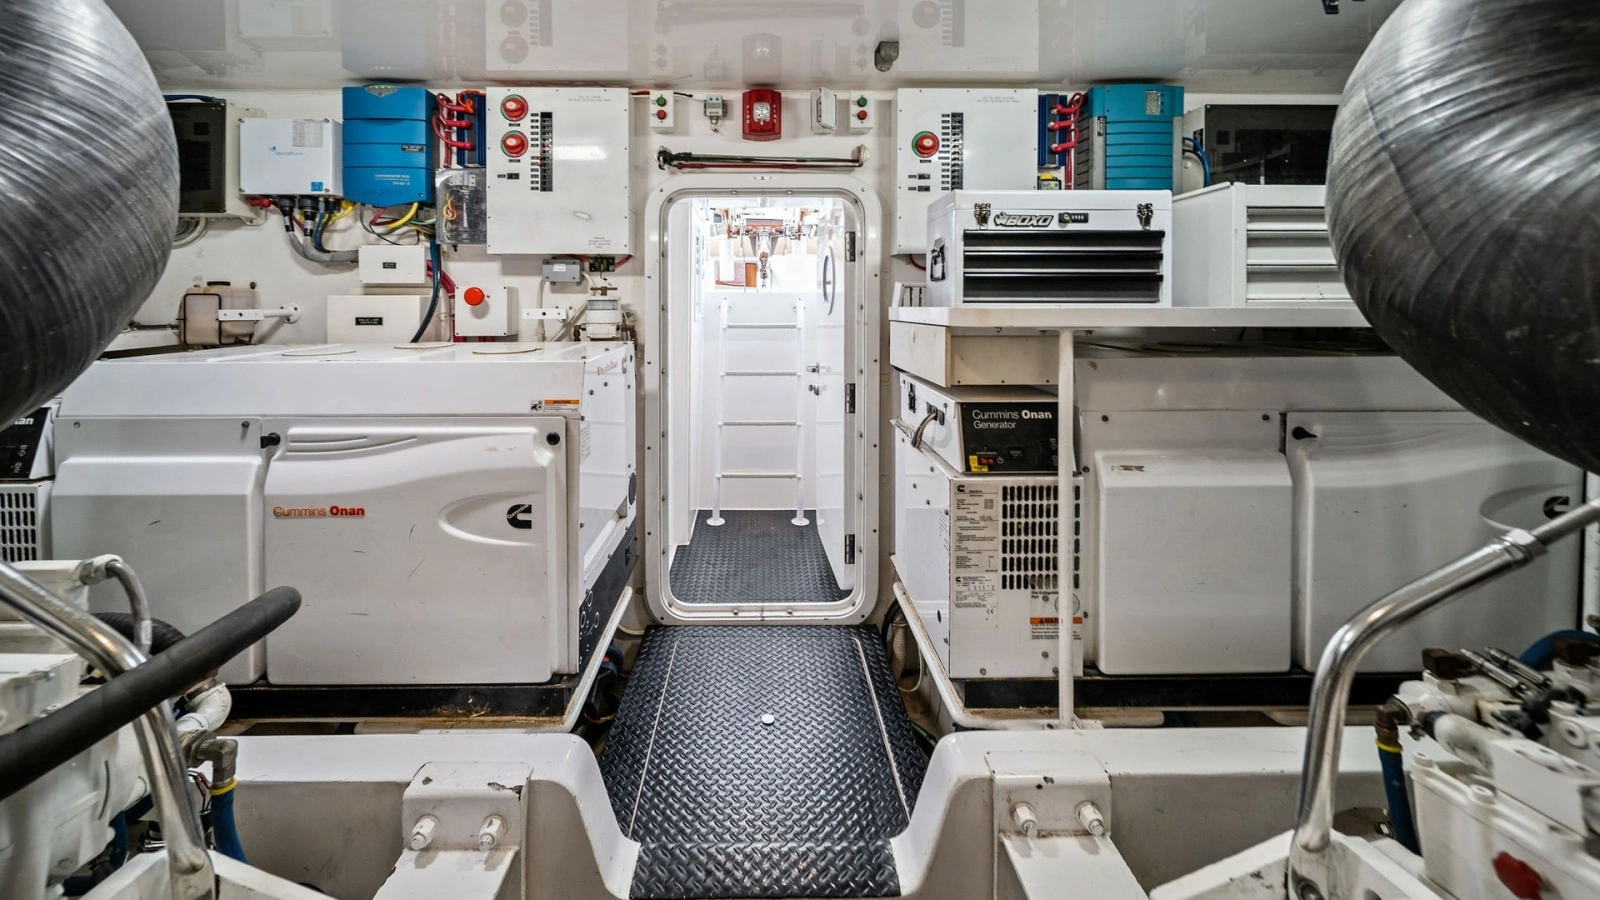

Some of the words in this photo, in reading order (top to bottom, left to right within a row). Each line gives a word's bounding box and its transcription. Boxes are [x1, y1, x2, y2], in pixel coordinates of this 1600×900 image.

[1005, 213, 1053, 226] BOXO
[972, 409, 1019, 420] Cummins
[1021, 409, 1053, 420] Onan
[973, 420, 1016, 430] Generator
[273, 506, 326, 517] Cummins
[329, 505, 365, 517] Onan
